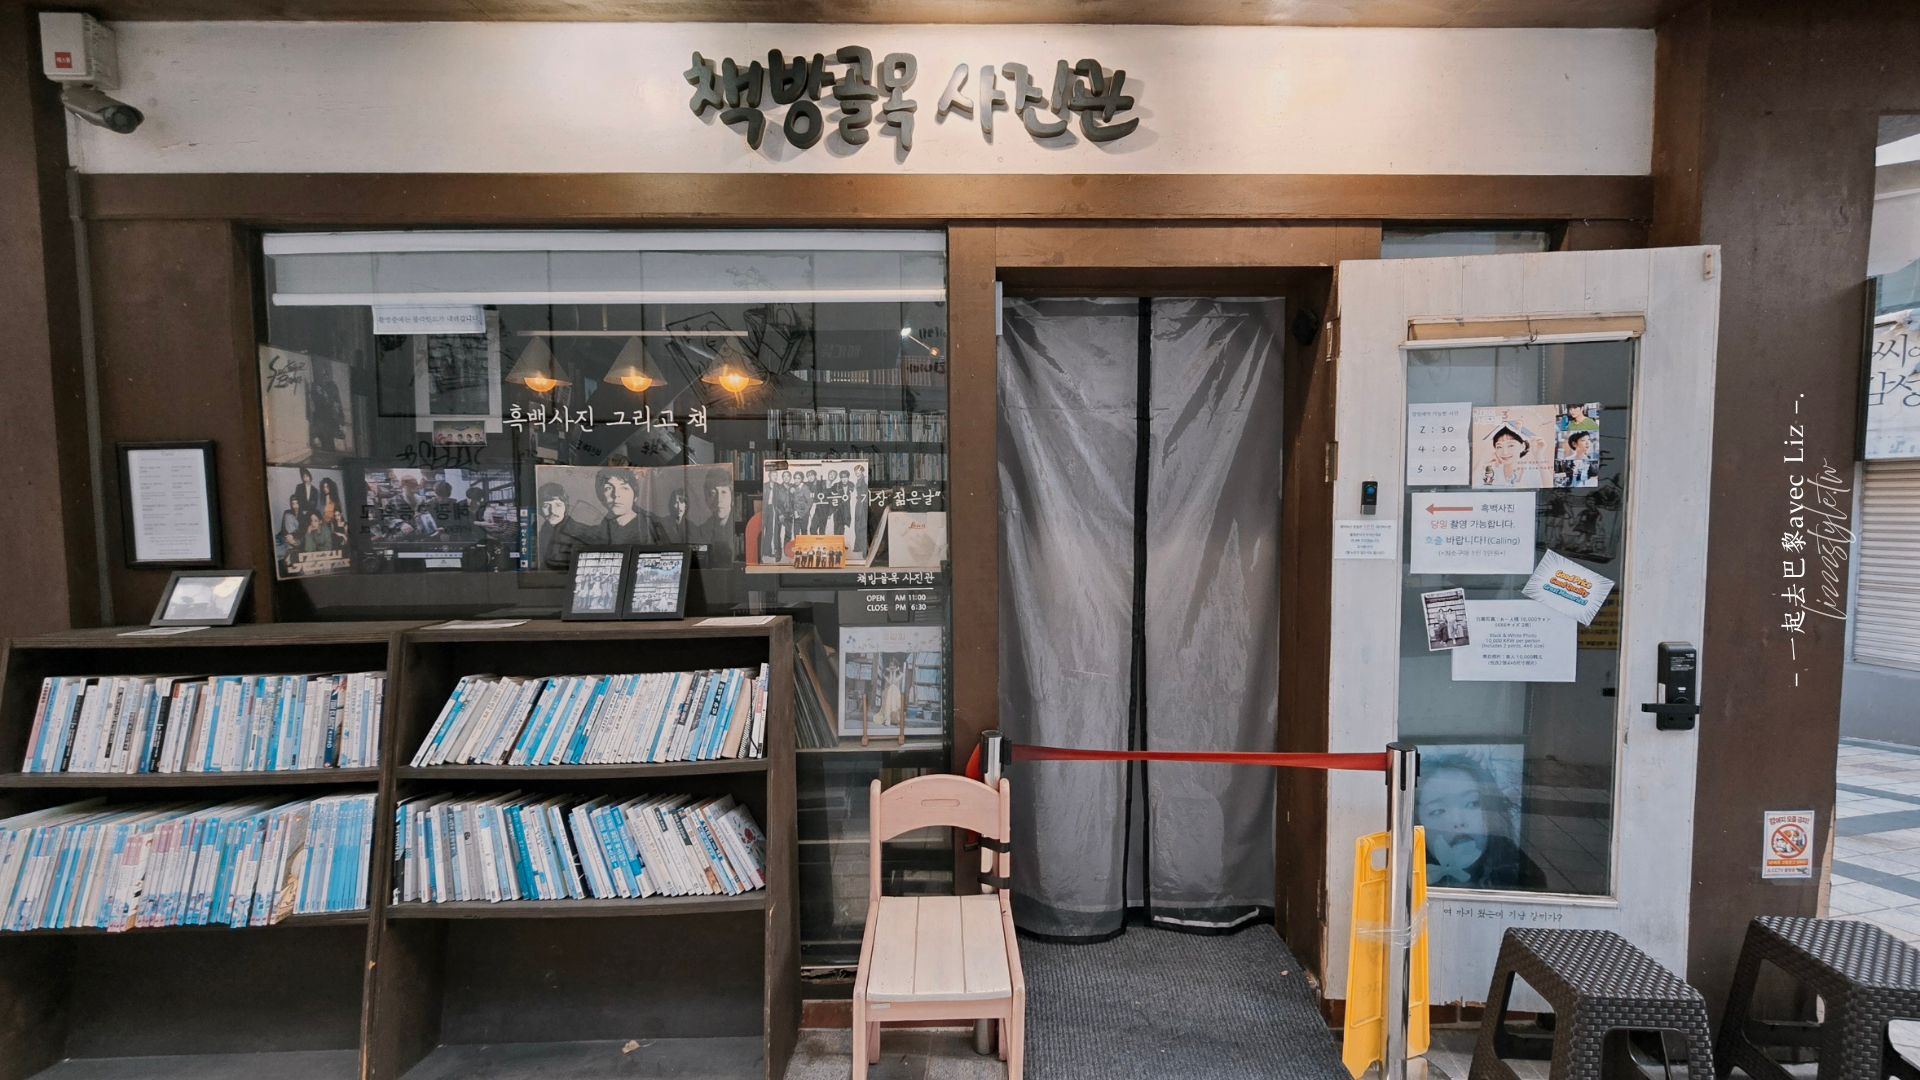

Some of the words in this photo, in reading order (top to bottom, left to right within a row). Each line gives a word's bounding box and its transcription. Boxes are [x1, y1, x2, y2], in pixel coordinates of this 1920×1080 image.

[683, 45, 918, 151] 책방골목
[937, 58, 1139, 143] 사진관
[503, 404, 594, 433] 흑백사진
[606, 405, 678, 433] 그리고
[687, 404, 708, 433] 책
[860, 491, 887, 507] 가장
[1480, 504, 1515, 513] 흑백사진
[1431, 519, 1447, 529] 당일
[1449, 519, 1467, 529] 촬영
[1470, 519, 1515, 529] 가능합니다.
[856, 571, 898, 586] 책방골목
[902, 571, 935, 585] 사진관
[1555, 570, 1572, 582] Good
[1570, 575, 1592, 589] Price
[1550, 577, 1568, 588] Good
[1566, 583, 1590, 598] Quality
[866, 594, 886, 602] OPEN
[895, 594, 906, 602] AM
[908, 594, 927, 602] 11:00
[866, 604, 888, 612] CLOSE
[895, 604, 907, 612] PM
[911, 604, 927, 612] 6:30
